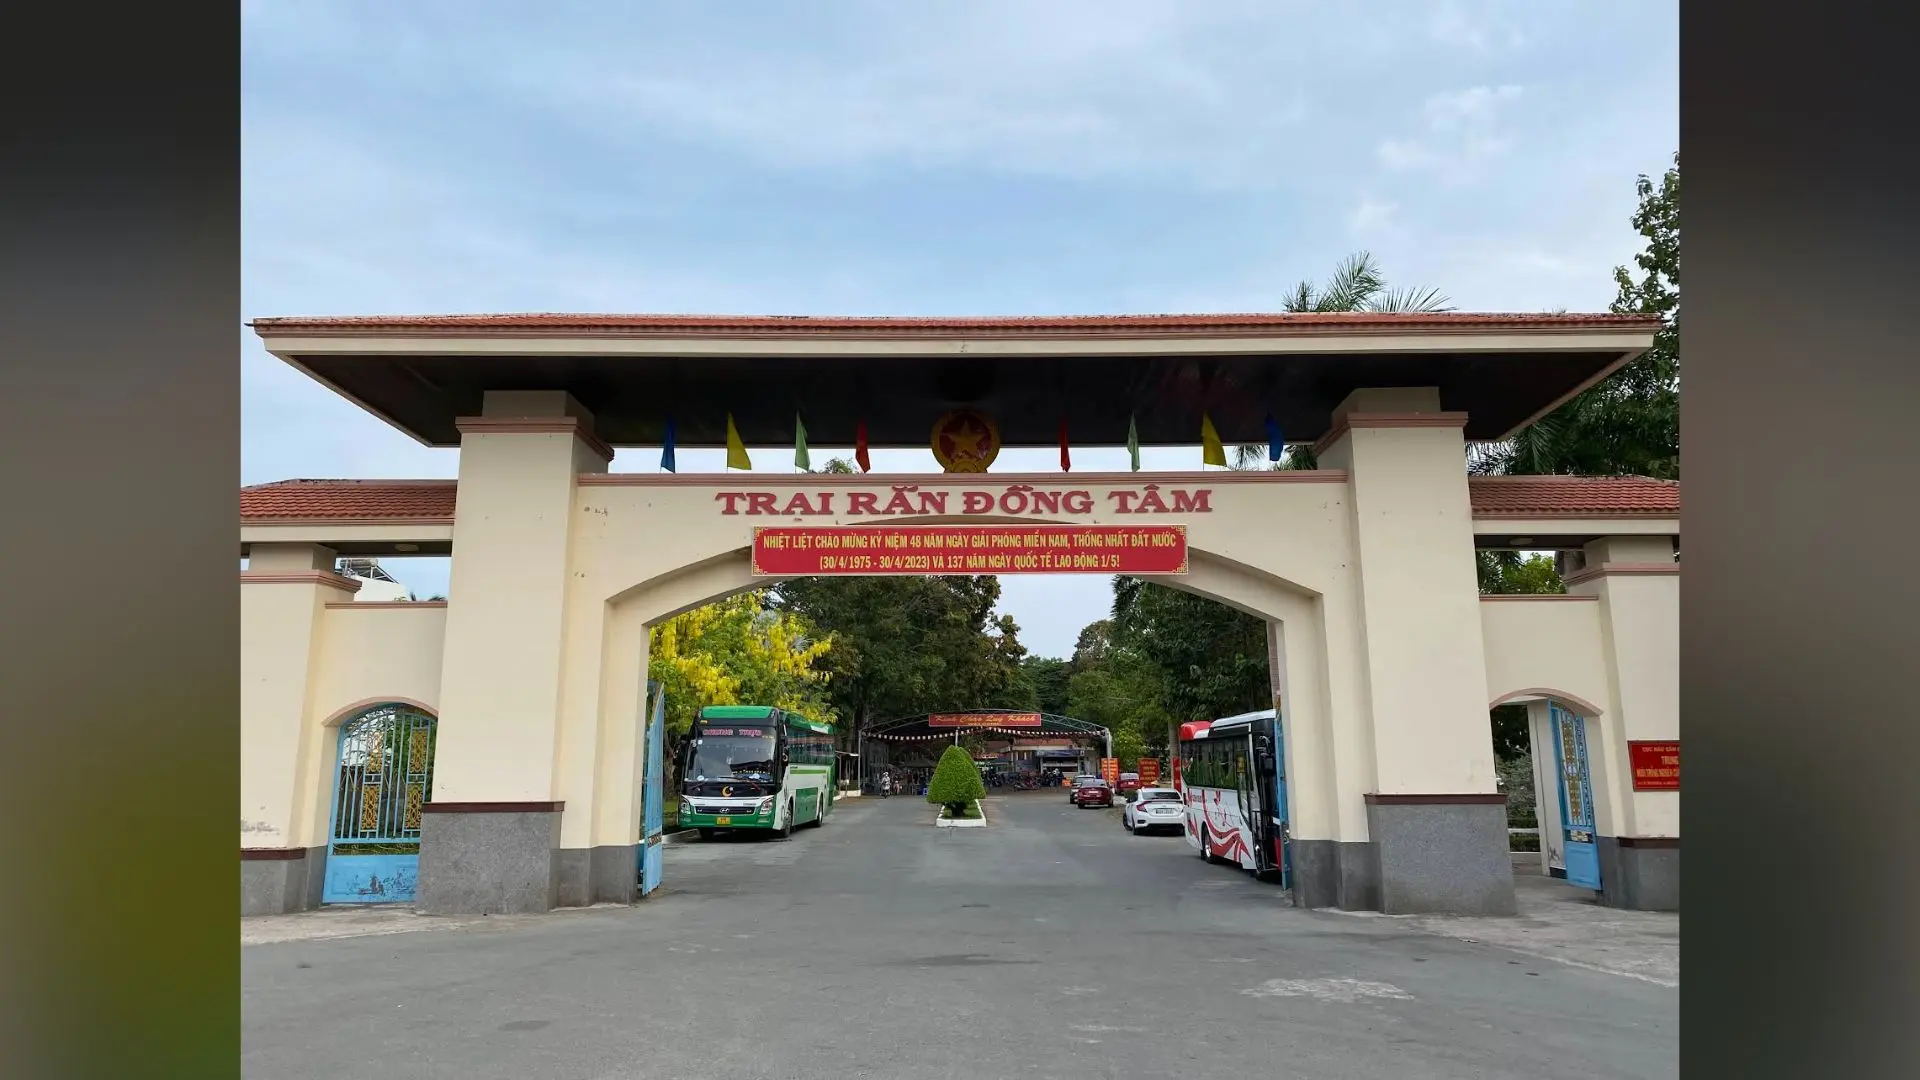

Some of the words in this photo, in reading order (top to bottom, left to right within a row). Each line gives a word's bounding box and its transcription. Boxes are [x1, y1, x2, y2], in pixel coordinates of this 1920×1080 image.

[962, 484, 1095, 515] ĐỒNG
[1108, 484, 1213, 514] TÂM
[763, 532, 790, 551] NHIỆT
[792, 532, 813, 551] LIỆT
[815, 532, 839, 549] CHÀO
[841, 532, 868, 549] MỪNG
[884, 532, 908, 551] NIỆM
[910, 535, 921, 548] 48
[923, 532, 944, 548] NĂM
[946, 531, 969, 548] NGÀY
[971, 530, 989, 548] GIẢI
[991, 531, 1021, 548] PHÓNG
[1048, 534, 1071, 549] NAM,
[1072, 529, 1103, 547] THỐNG
[1105, 529, 1129, 547] NHẤT
[1131, 529, 1149, 547] ĐẤT
[1151, 531, 1177, 547] NƯỚC
[819, 555, 871, 570] (30/4/1975
[879, 555, 930, 570] 30/4/2023)
[932, 552, 944, 568] VÀ
[947, 555, 963, 569] 137
[988, 552, 1012, 568] NGÀY
[1014, 550, 1038, 569] QUỐC
[1039, 550, 1052, 568] TẾ
[1054, 555, 1072, 567] LAO
[1074, 551, 1099, 570] ĐỘNG
[1101, 554, 1120, 568] 1/5!
